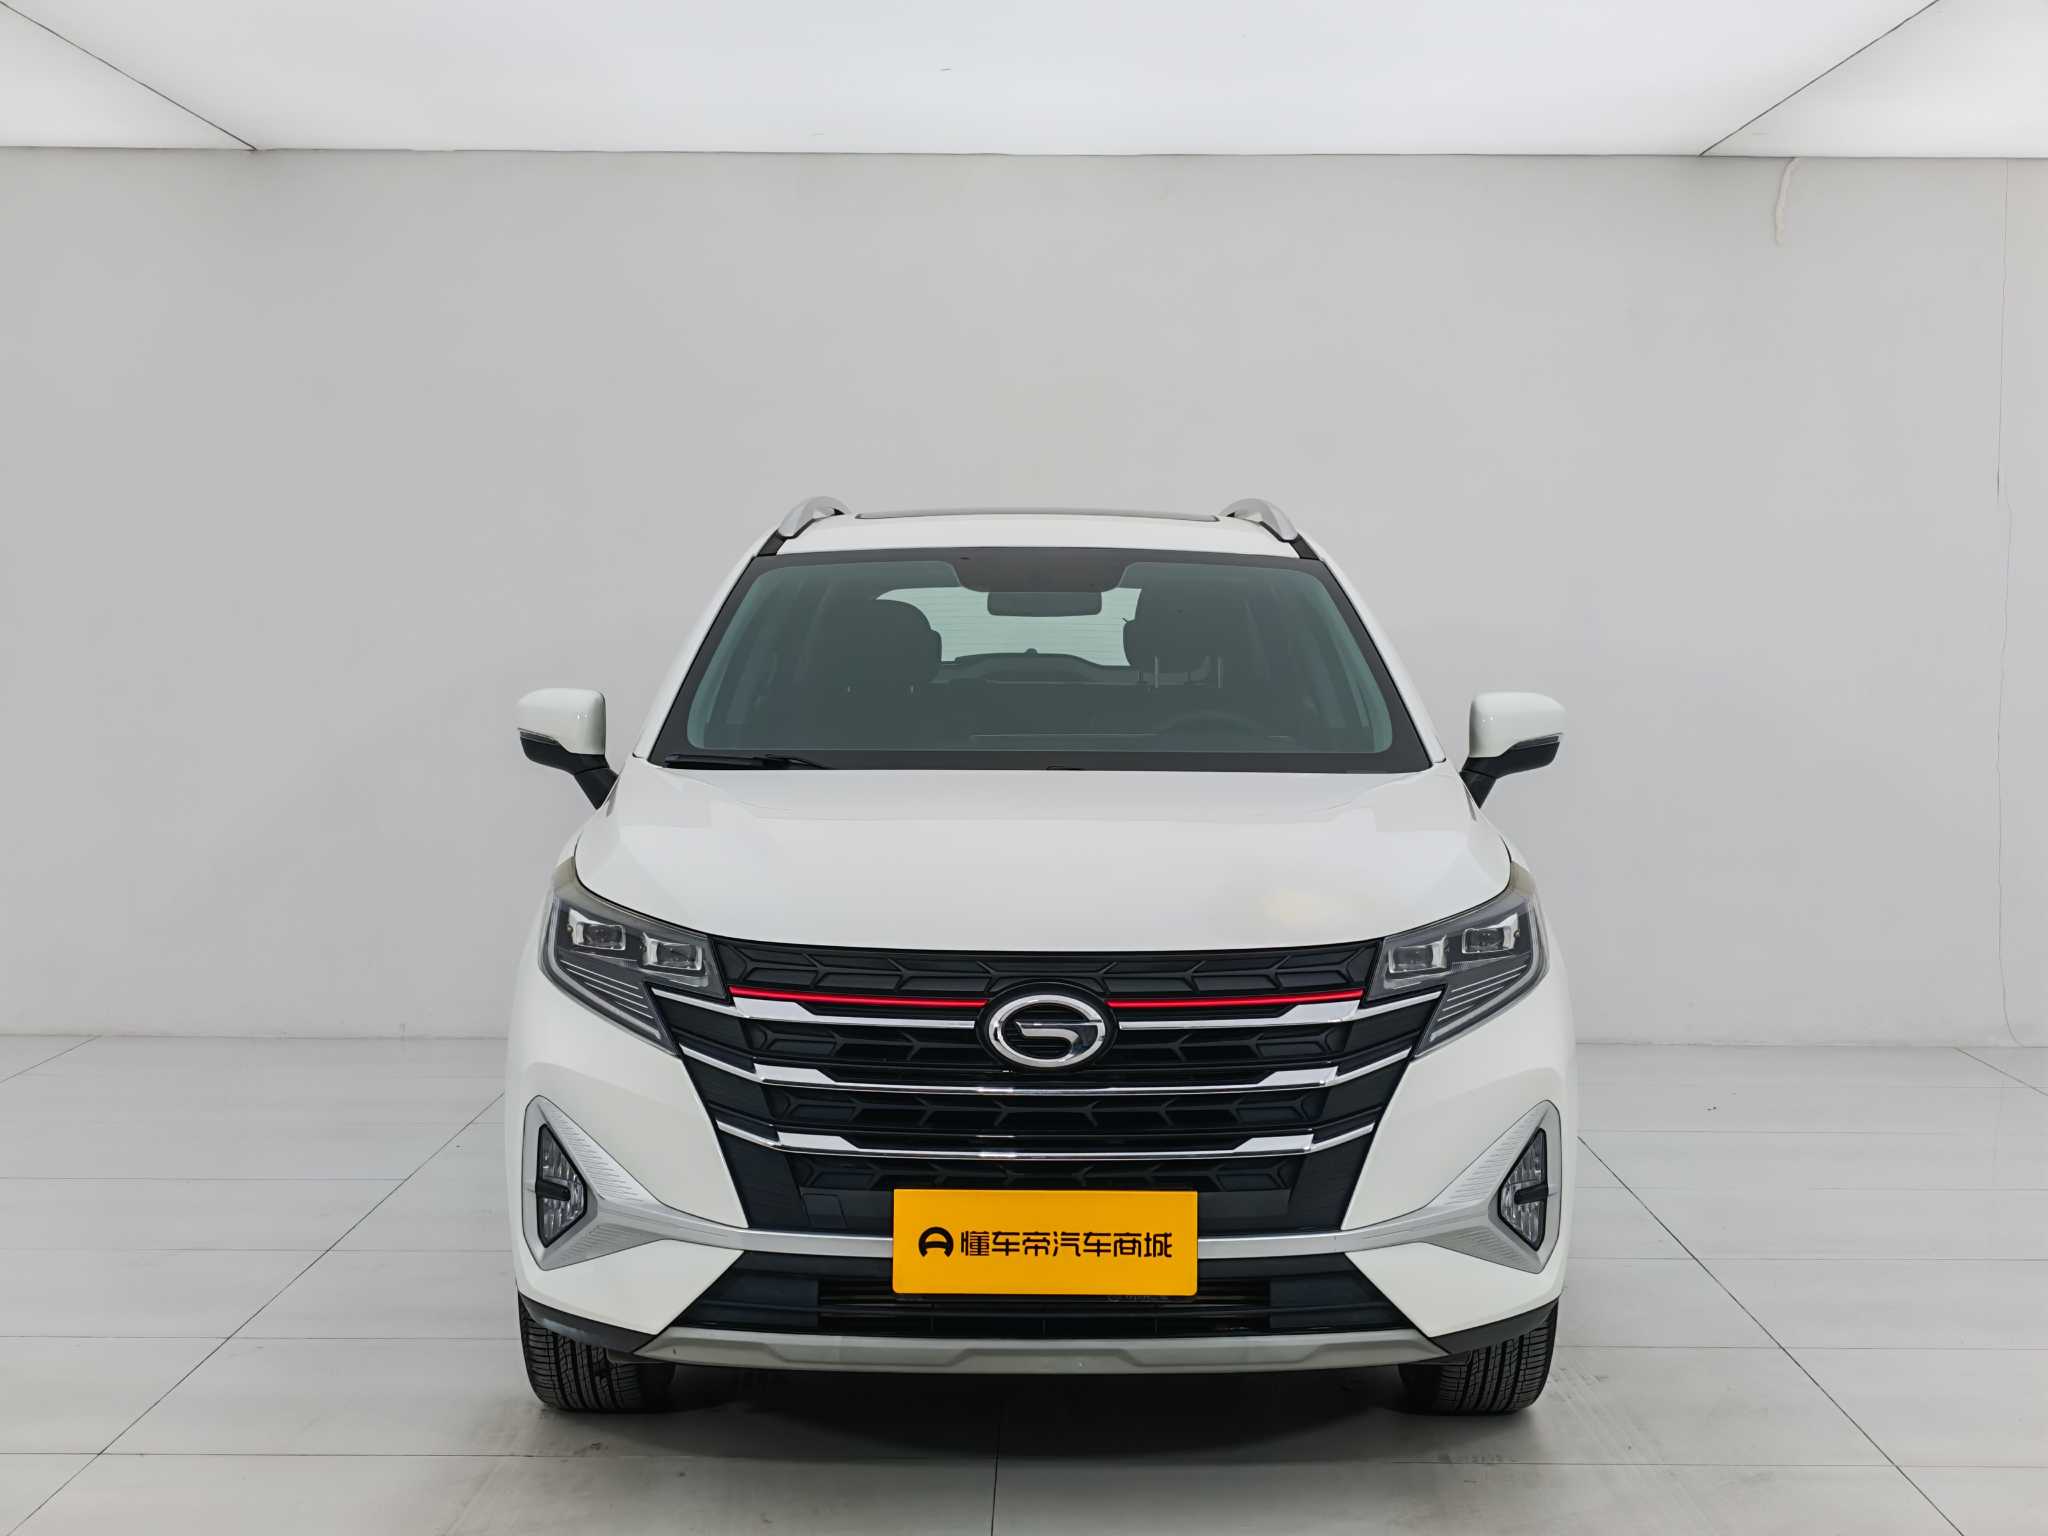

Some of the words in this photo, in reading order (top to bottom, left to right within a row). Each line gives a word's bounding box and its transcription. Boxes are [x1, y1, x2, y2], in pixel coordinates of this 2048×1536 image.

[960, 1230, 1173, 1258] 懂车帝汽车商城
